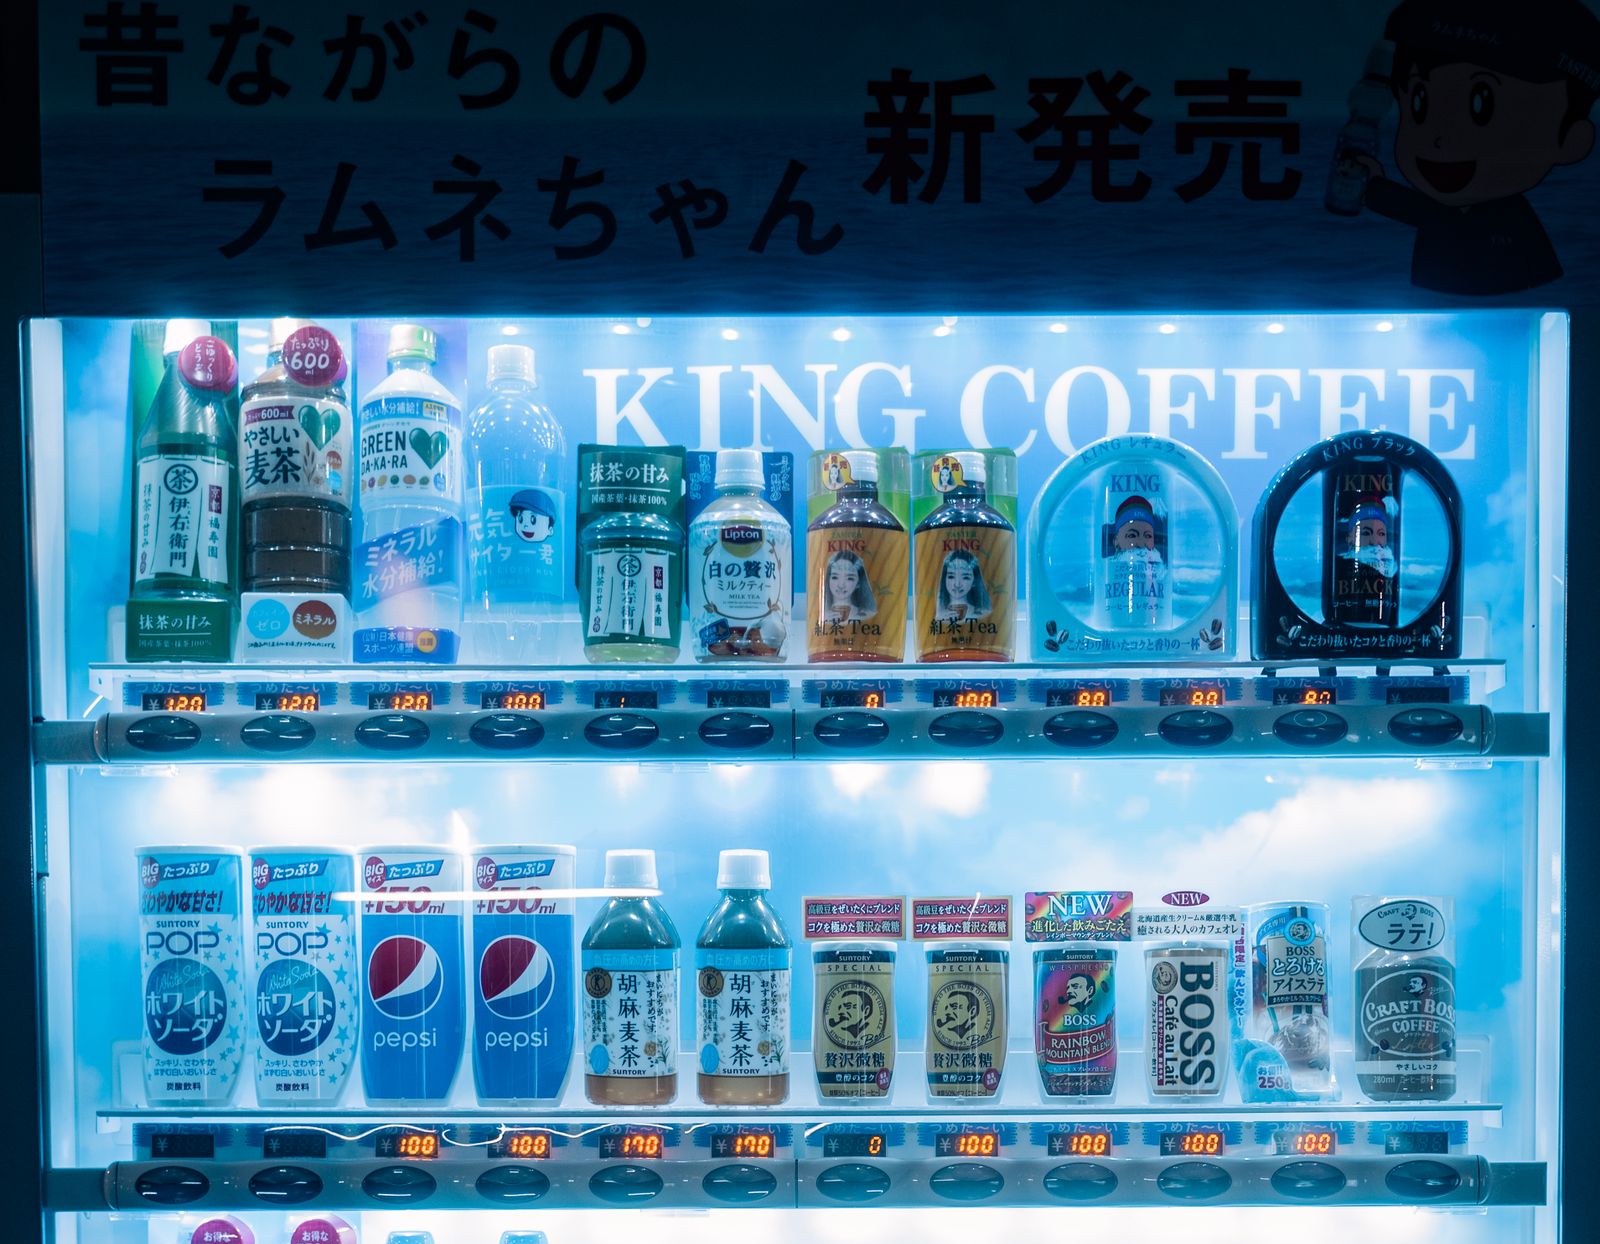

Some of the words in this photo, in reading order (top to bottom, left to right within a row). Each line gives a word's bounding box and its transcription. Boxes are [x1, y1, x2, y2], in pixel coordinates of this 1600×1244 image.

[77, 2, 648, 110] 昔ながらの
[862, 67, 1303, 204] 新発売
[203, 154, 846, 263] ラムネちゃん
[290, 353, 330, 371] 600
[584, 360, 927, 463] KING
[960, 359, 1476, 462] COFFEE
[244, 426, 300, 449] やさしい
[362, 430, 406, 458] GREEN
[1080, 437, 1122, 464] KING
[1129, 436, 1187, 460] レギュラー
[1322, 436, 1363, 462] KING
[1370, 435, 1416, 457] ブラック
[244, 446, 302, 490] 麦茶
[589, 463, 670, 484] 抹茶の甘み
[1110, 474, 1161, 493] KING
[1343, 473, 1394, 492] KING
[169, 496, 191, 569] 伊右衛門
[469, 508, 514, 541] 元気
[724, 529, 761, 544] Lipton
[943, 539, 981, 552] KING
[365, 526, 438, 566] ミネラル
[828, 540, 867, 553] KING
[362, 549, 445, 598] 水分補給!
[709, 561, 777, 580] 白の贅沢
[1104, 583, 1165, 600] REGULAR
[1338, 579, 1394, 596] BLACK
[139, 614, 213, 632] 抹茶の甘み
[295, 612, 336, 627] ミネラル
[815, 619, 845, 636] 紅茶
[847, 618, 882, 635] Tea
[928, 619, 962, 636] 紅茶
[964, 617, 999, 634] Tea
[1066, 637, 1201, 653] こだわり抜いたコクと香りの一杯
[1299, 635, 1431, 649] こだわり抜いたコクと香りの一杯
[142, 863, 160, 877] BIG
[253, 863, 269, 877] BIG
[273, 863, 319, 880] たっぷり
[366, 863, 385, 878] BIG
[389, 862, 436, 879] たっぷり
[477, 863, 496, 878] BIG
[500, 863, 547, 879] たっぷり
[365, 886, 445, 915] +150ml
[476, 886, 556, 915] +150ml
[1048, 894, 1113, 916] NEW
[1171, 892, 1203, 905] NEW
[808, 903, 901, 917] 高級豆をぜいたくにブレンド
[156, 920, 201, 929] SUNTORY
[266, 921, 310, 930] SUNTORY
[808, 922, 901, 935] コクを極めた贅沢な微糖
[916, 922, 1007, 935] コクを極めた贅沢な微糖
[1032, 919, 1127, 933] 進化した飲みごたえ
[1137, 924, 1239, 936] 癒される大人のカフェオレ
[1388, 921, 1435, 946] ラテ!
[146, 931, 220, 956] POP
[257, 931, 330, 957] POP
[1286, 946, 1315, 957] BOSS
[828, 963, 883, 973] SPECIAL
[935, 963, 990, 973] SPECIAL
[1273, 957, 1325, 977] とろける
[1273, 978, 1325, 993] アイスラテ
[147, 991, 225, 1017] ホワイト
[257, 991, 333, 1017] ホワイト
[154, 1014, 223, 1042] ソーダ
[266, 1014, 332, 1043] ソーダ
[618, 973, 640, 1067] 胡麻麦茶
[729, 973, 754, 1066] 胡麻麦茶
[1064, 1014, 1098, 1027] BOSS
[1179, 961, 1216, 1086] BOSS
[1392, 1018, 1441, 1034] COFFEE
[374, 1027, 437, 1052] pepsi
[485, 1027, 547, 1052] pepsi
[1051, 1031, 1106, 1050] RAINBOW
[825, 1051, 886, 1069] 贅沢微糖
[933, 1051, 994, 1069] 贅沢微糖
[1396, 1062, 1438, 1071] やさしいコク
[166, 1083, 202, 1092] 炭酸飲料
[276, 1084, 310, 1093] 炭酸飲料
[400, 1136, 436, 1154] 100
[511, 1136, 548, 1155] 100
[624, 1136, 660, 1155] 170
[736, 1136, 771, 1155] 170
[869, 1136, 882, 1154] 0
[959, 1135, 995, 1153] 100
[1071, 1135, 1107, 1153] 100
[1184, 1134, 1220, 1152] 100
[1296, 1134, 1331, 1152] 100
